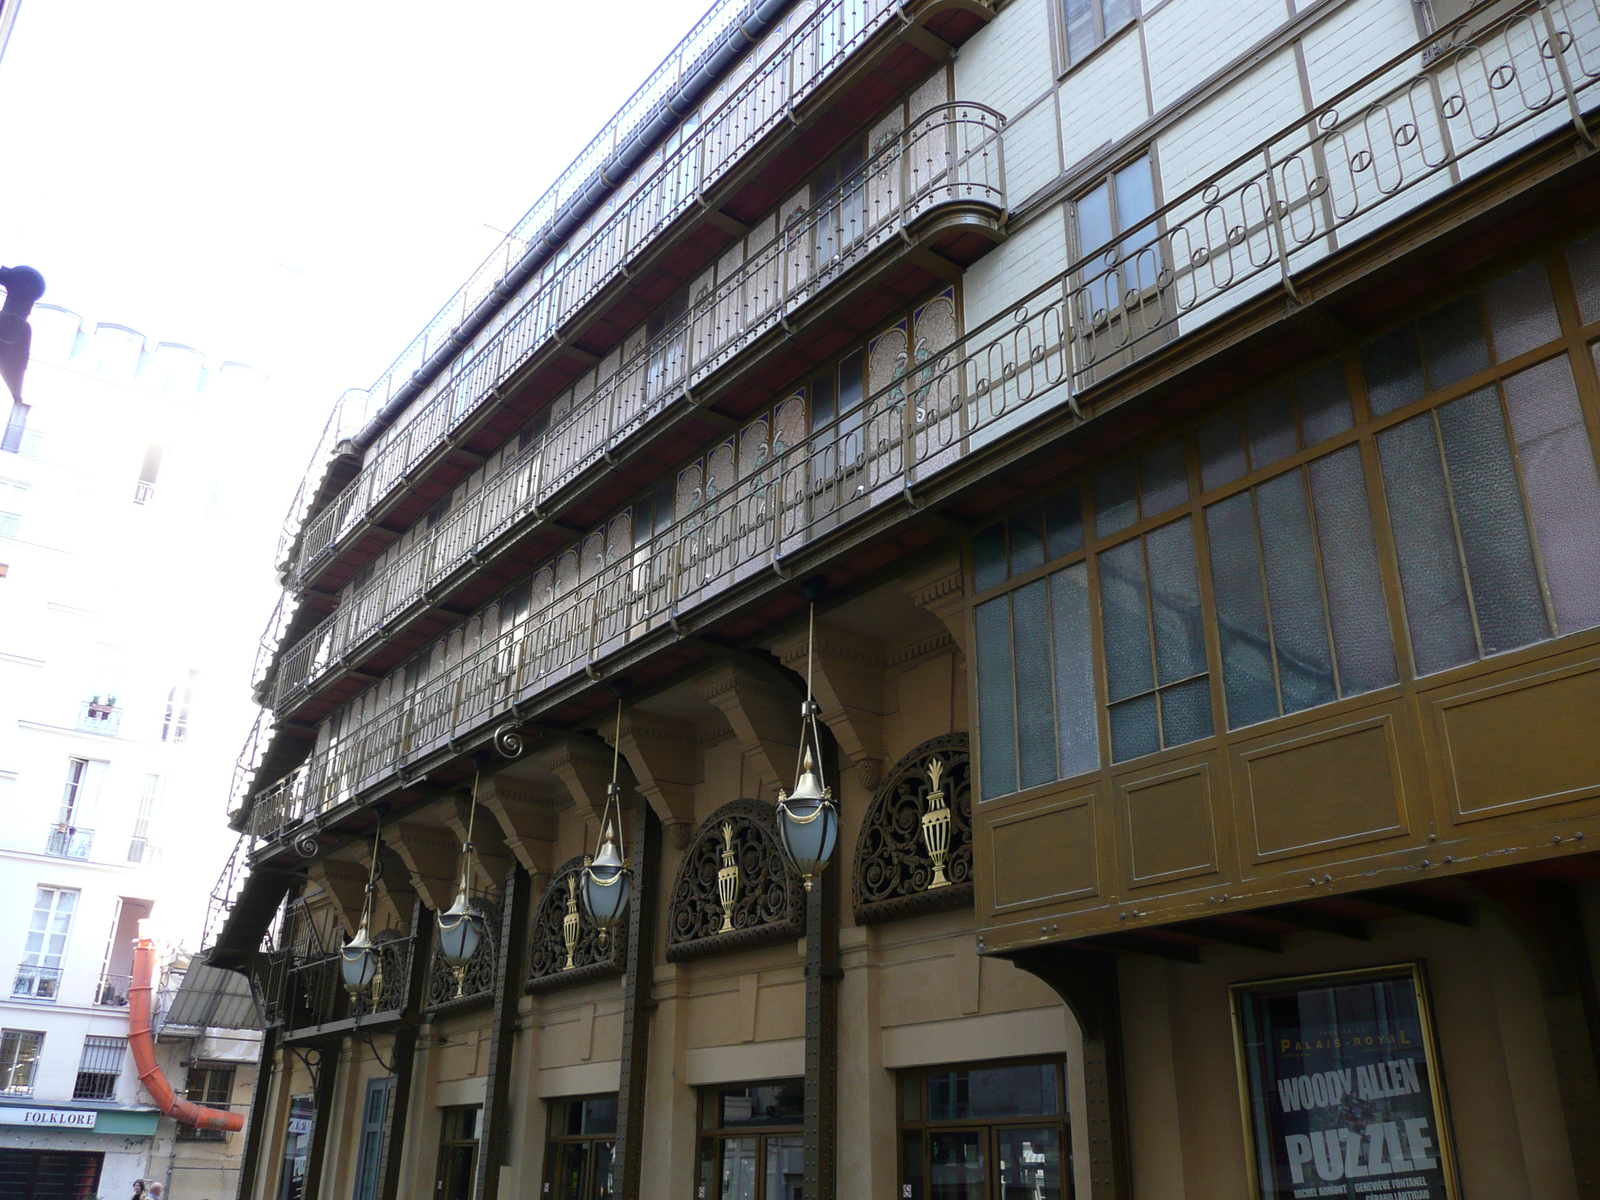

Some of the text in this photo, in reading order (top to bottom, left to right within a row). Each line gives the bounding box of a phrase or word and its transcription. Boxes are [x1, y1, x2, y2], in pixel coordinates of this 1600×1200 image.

[1277, 1058, 1421, 1113] WOODY ALLEN
[24, 1111, 94, 1125] FOLKLORE
[1284, 1117, 1438, 1184] PUZZLE
[1391, 1176, 1428, 1189] FONTANEL
[1293, 1187, 1318, 1199] MICHEL
